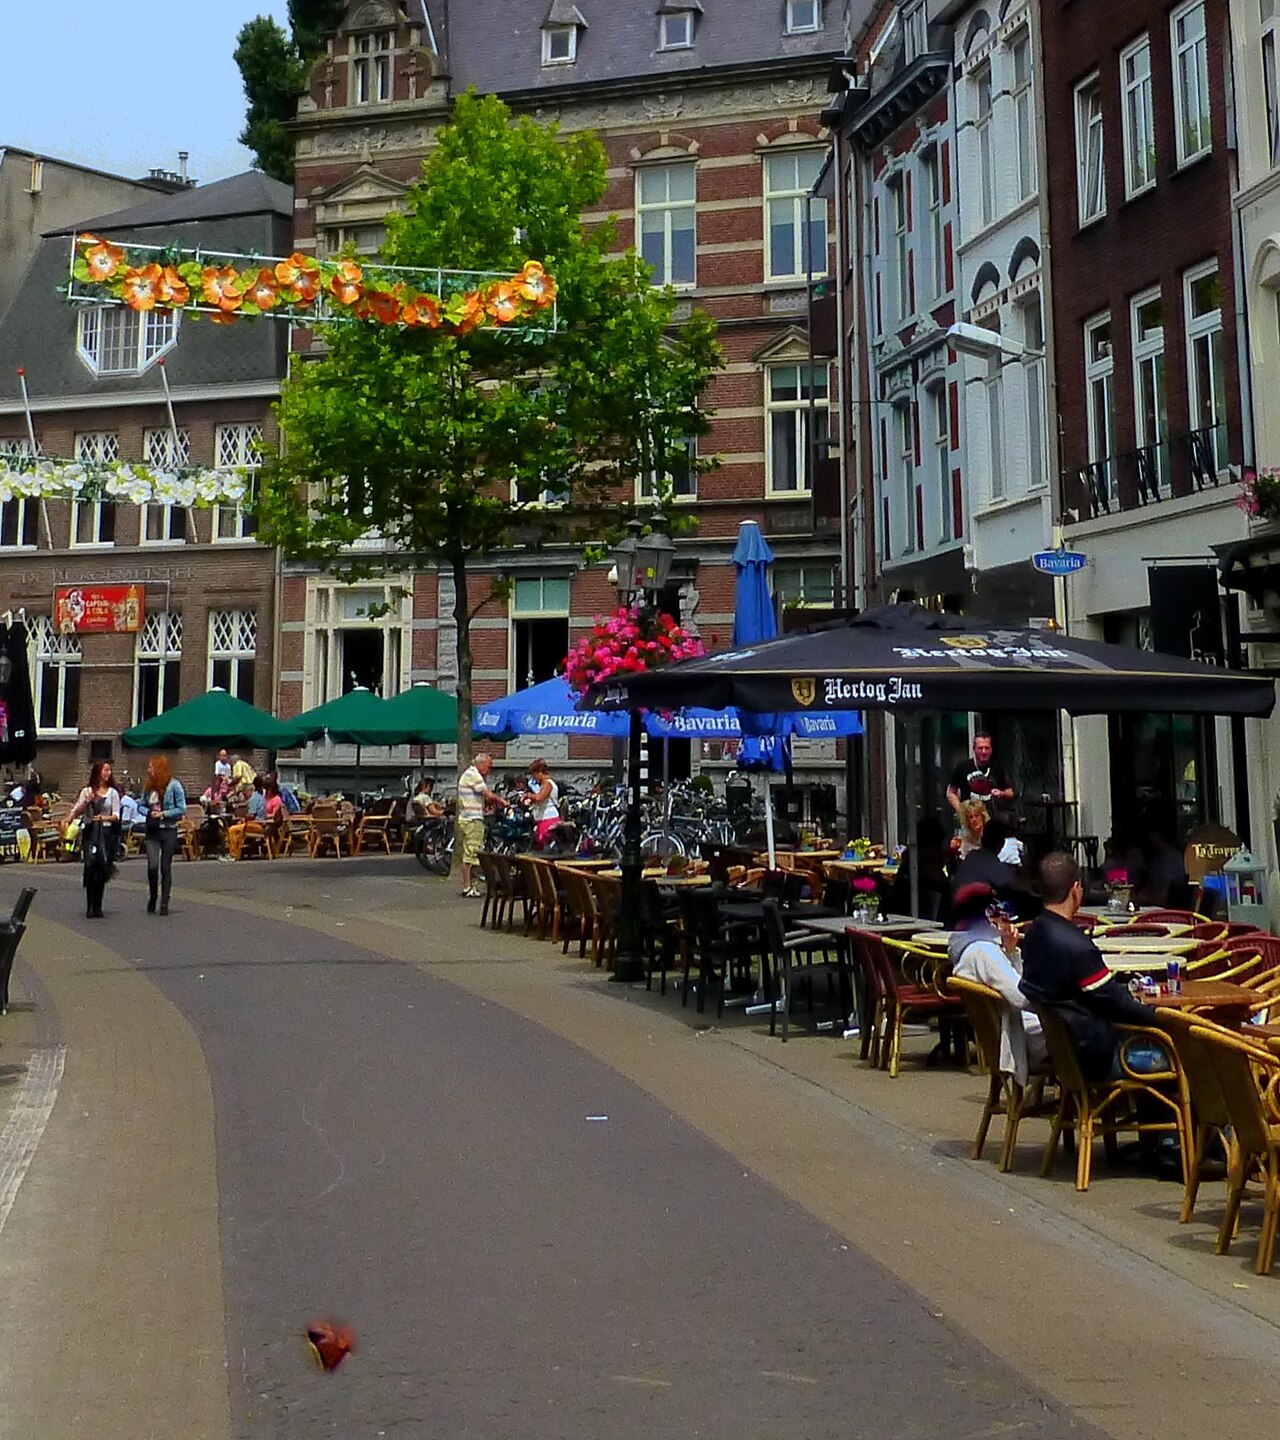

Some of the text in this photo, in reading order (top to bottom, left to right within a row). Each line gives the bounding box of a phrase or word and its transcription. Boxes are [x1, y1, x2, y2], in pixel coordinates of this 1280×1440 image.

[1039, 556, 1081, 569] Bavaria
[823, 676, 923, 705] Hertog Jan
[537, 712, 597, 730] Bavaria
[674, 713, 741, 731] Bavaria
